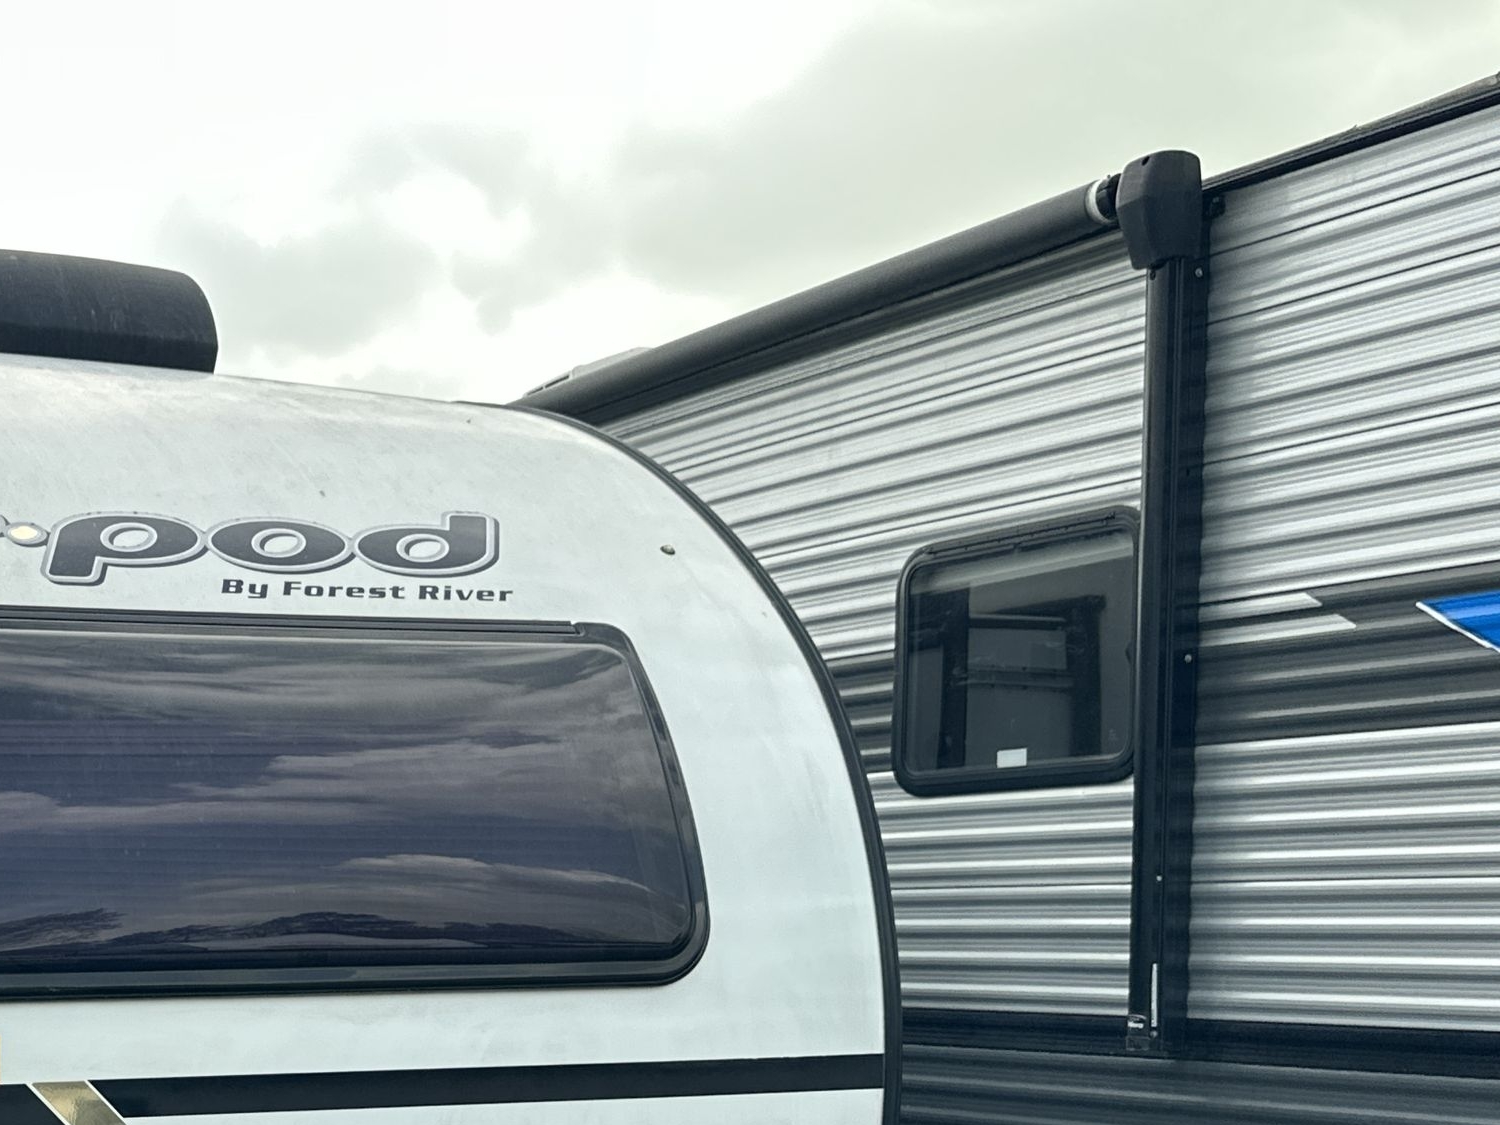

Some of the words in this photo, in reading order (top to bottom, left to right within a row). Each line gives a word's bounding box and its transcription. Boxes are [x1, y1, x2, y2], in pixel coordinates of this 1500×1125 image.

[221, 578, 268, 599] By
[283, 581, 406, 600] Forest
[418, 585, 514, 602] River
